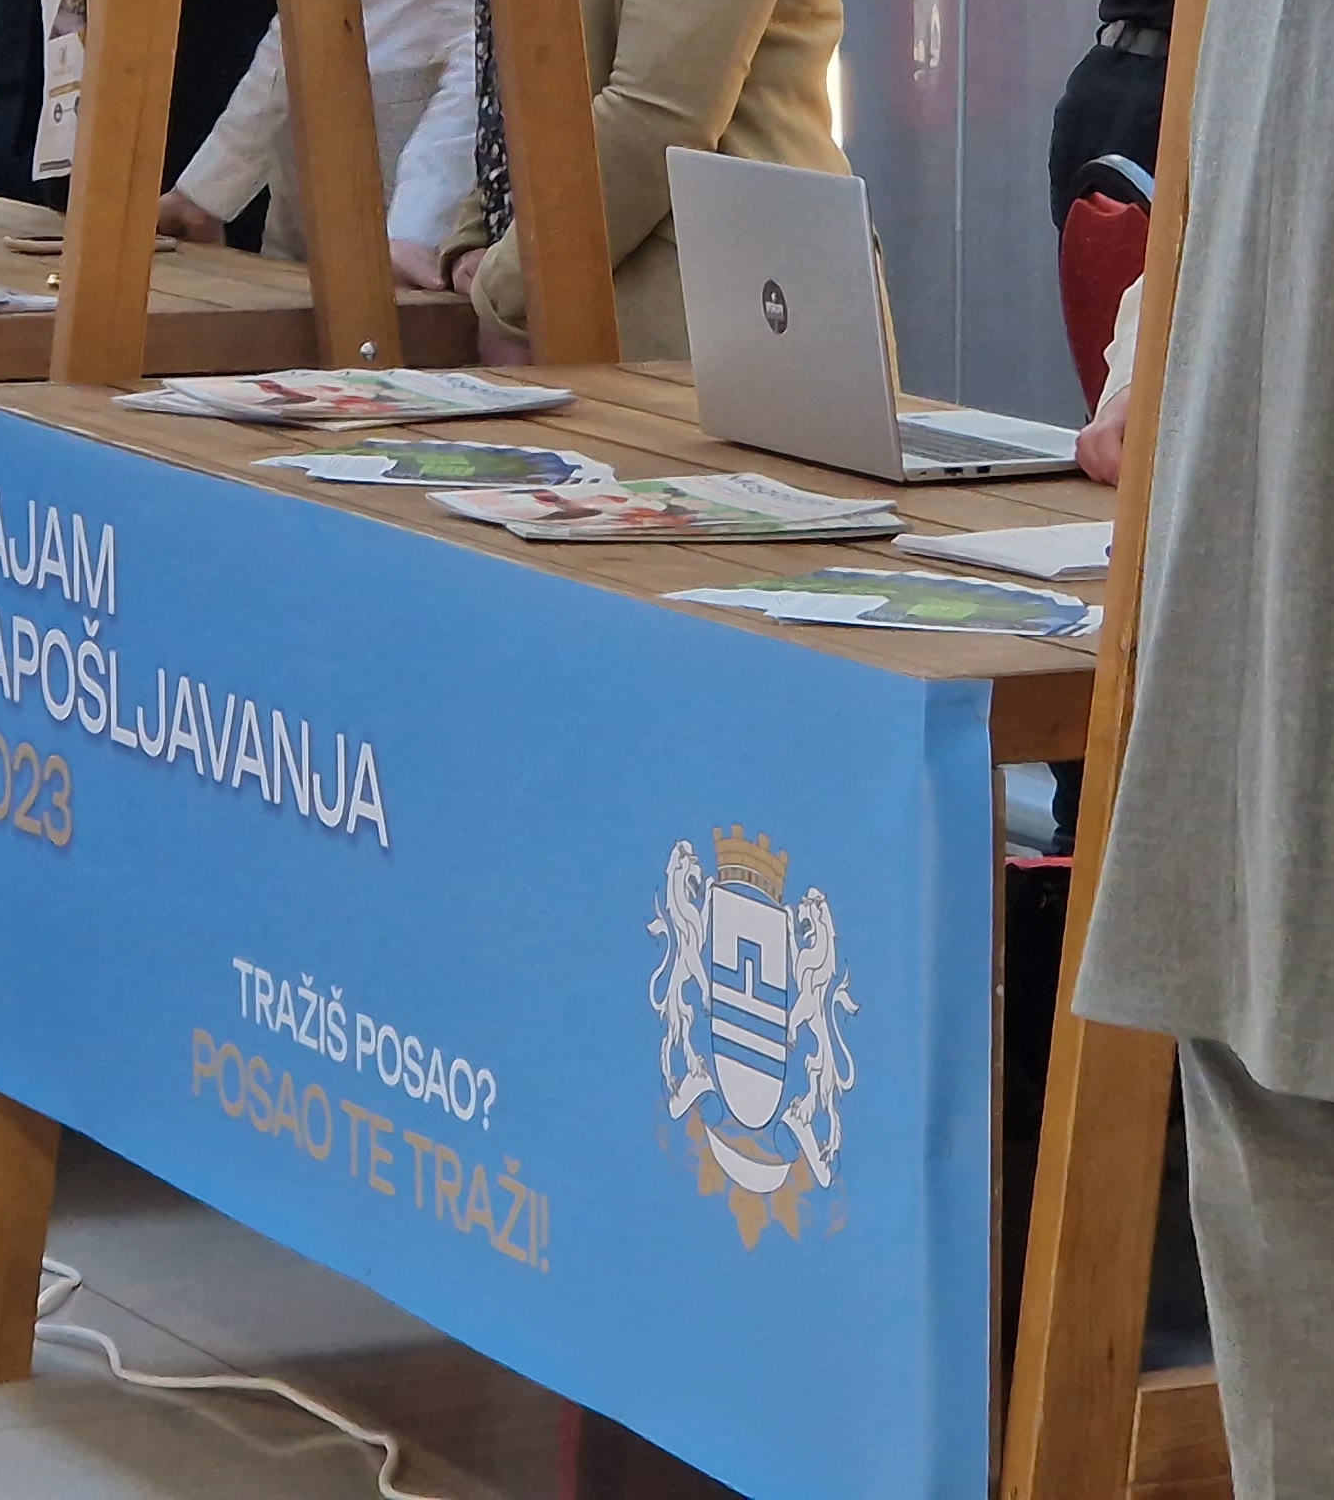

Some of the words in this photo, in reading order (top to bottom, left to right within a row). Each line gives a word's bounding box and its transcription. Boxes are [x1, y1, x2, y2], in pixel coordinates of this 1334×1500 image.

[232, 955, 348, 1063] TRAŽIŠ
[355, 1011, 497, 1131] POSAO?
[192, 1027, 333, 1161] POSAO
[340, 1098, 396, 1197] TE
[403, 1128, 550, 1274] TRAŽI!
